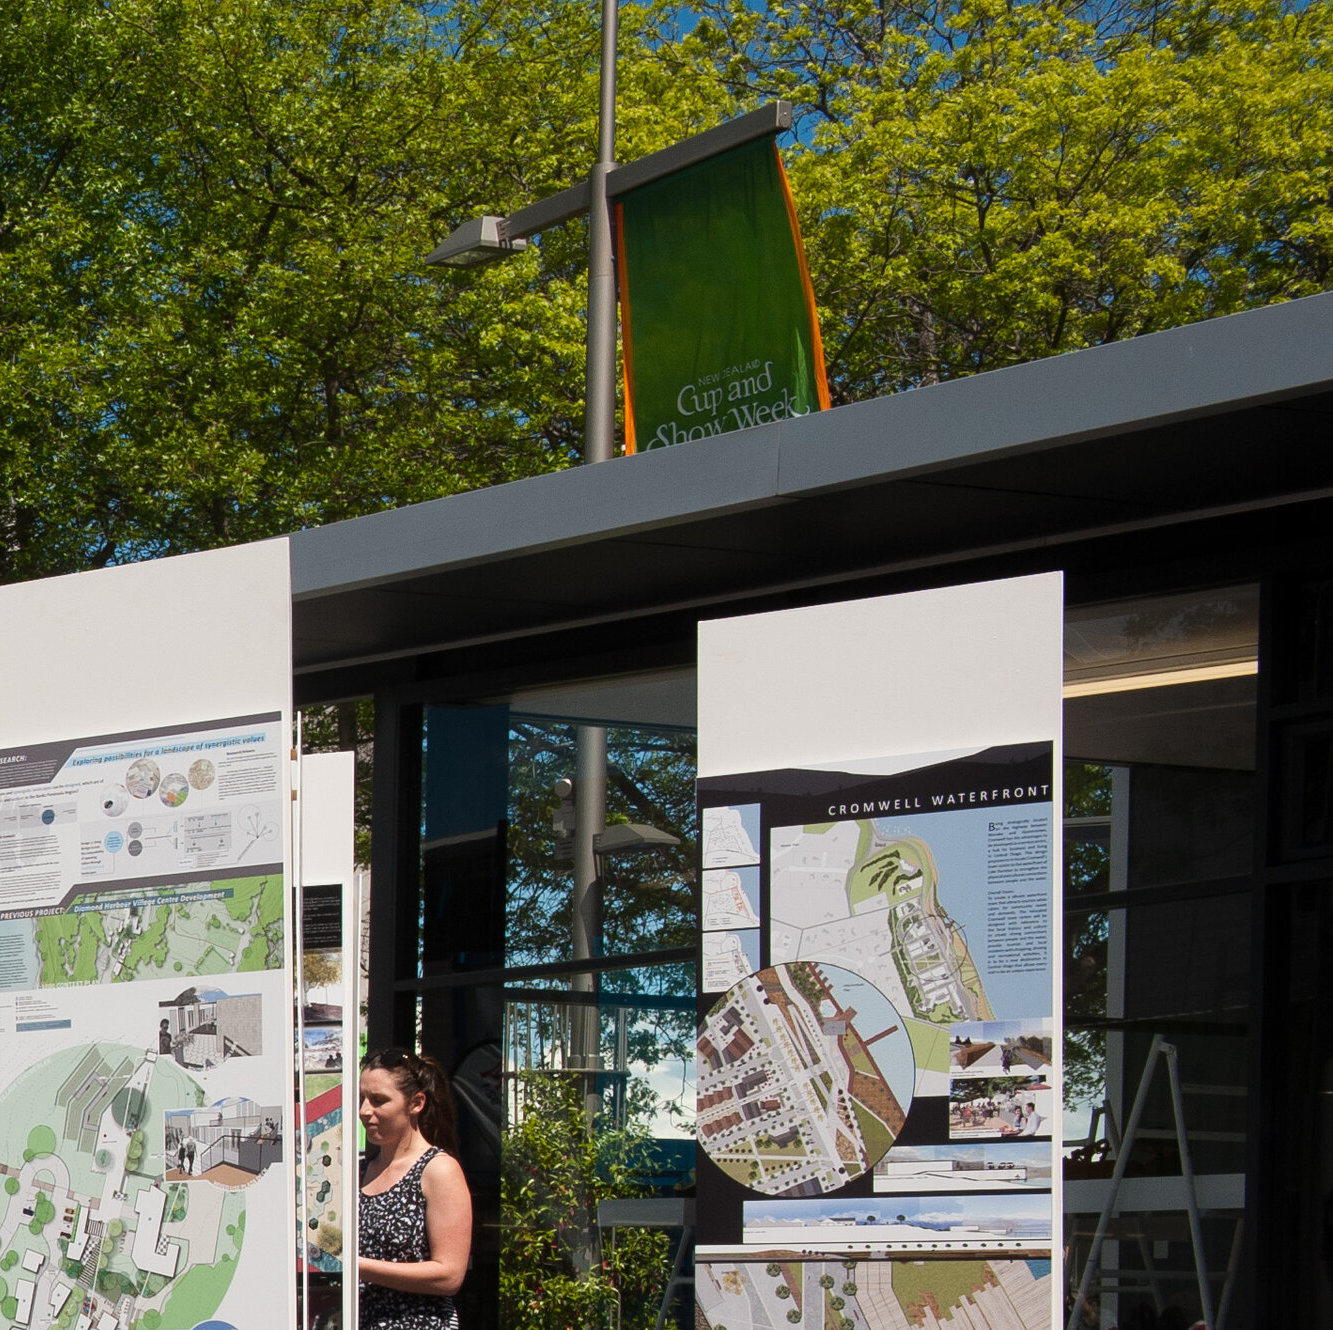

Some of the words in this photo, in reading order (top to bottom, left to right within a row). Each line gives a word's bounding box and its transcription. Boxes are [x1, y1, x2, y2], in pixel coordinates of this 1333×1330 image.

[677, 384, 724, 417] Cup
[728, 361, 774, 402] and
[698, 374, 720, 387] NEW
[646, 415, 728, 451] Show
[727, 388, 811, 430] Week
[72, 755, 103, 766] Exploring
[103, 751, 142, 762] possibilities
[143, 749, 154, 758] for
[161, 744, 194, 755] landscape
[195, 742, 204, 750] of
[204, 737, 242, 750] synergistic
[242, 735, 264, 744] values
[828, 797, 922, 816] CROMWELL
[932, 784, 1050, 806] WATERFRONT
[0, 908, 34, 920] PREVIOUS
[74, 903, 103, 913] Diamond
[104, 901, 131, 910] Harbour
[132, 898, 156, 908] Village
[157, 896, 179, 904] Centre
[180, 891, 225, 903] Development
